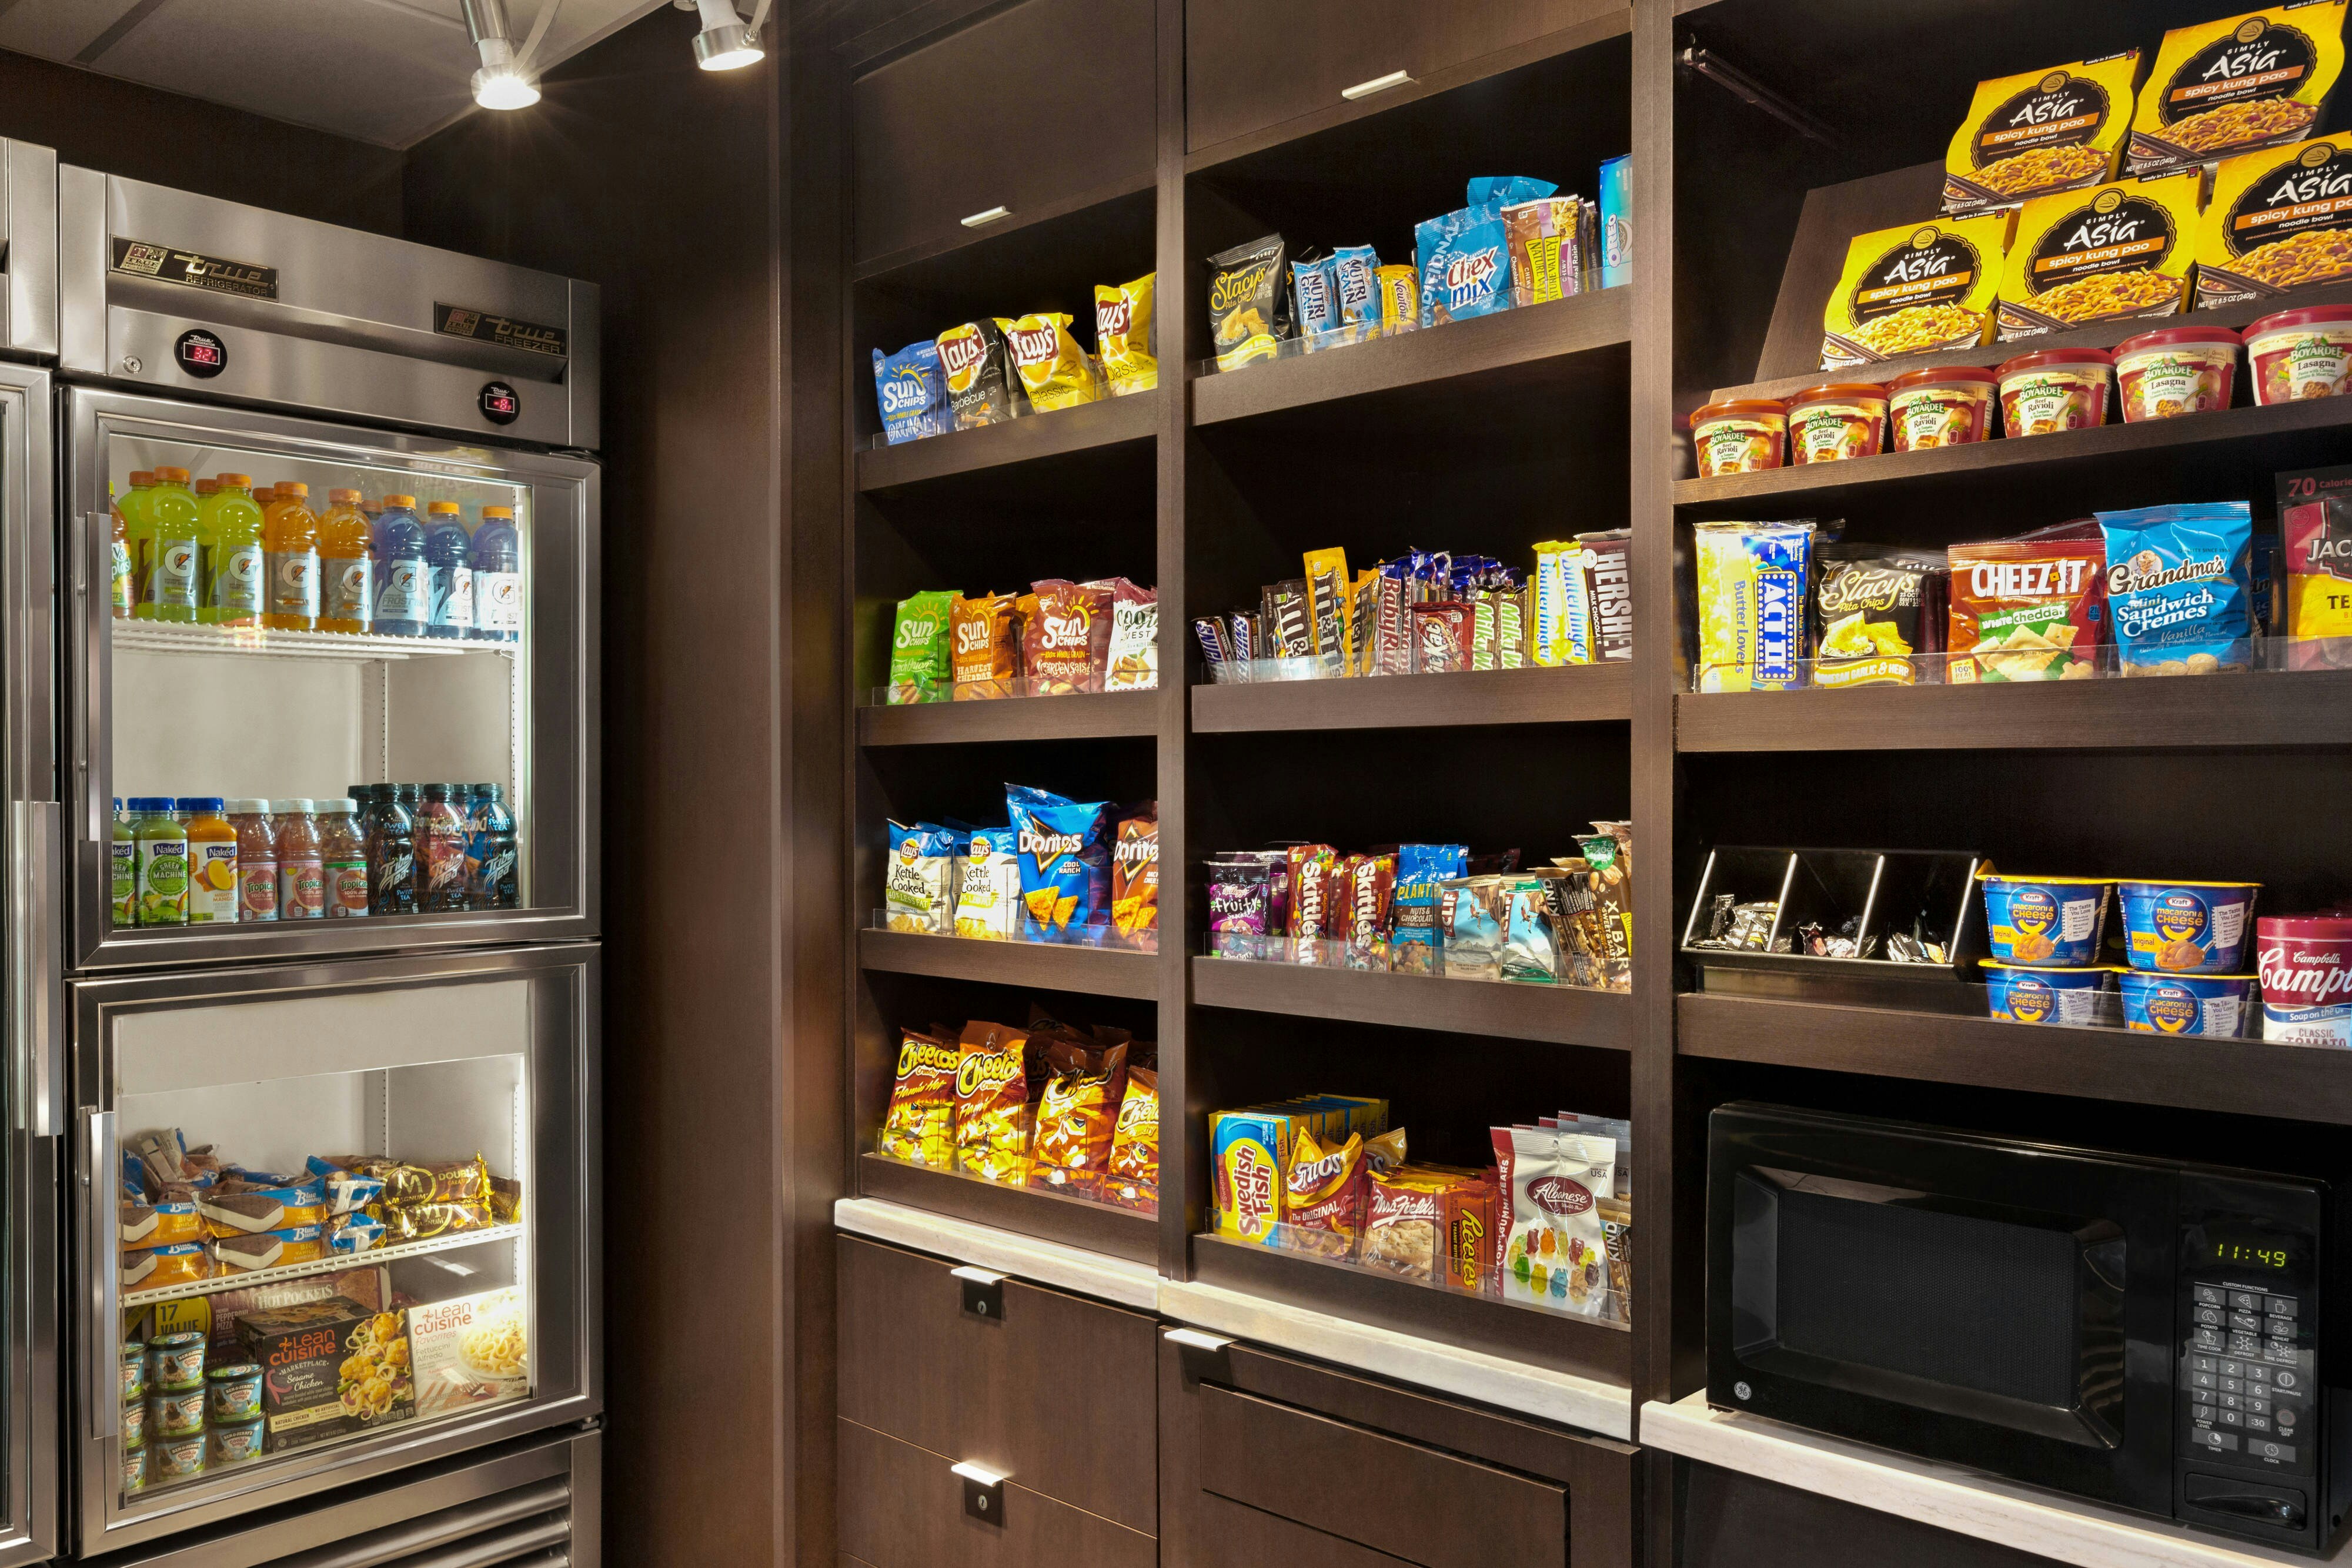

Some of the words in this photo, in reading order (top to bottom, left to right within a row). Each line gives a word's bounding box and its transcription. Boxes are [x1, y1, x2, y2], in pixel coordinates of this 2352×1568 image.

[2227, 41, 2270, 55] SIMPLY
[2203, 49, 2280, 81] Asia
[2185, 83, 2219, 98] spicy
[2223, 77, 2256, 89] kung
[2259, 71, 2288, 85] pao
[2032, 91, 2070, 103] SIMPLY
[2208, 91, 2235, 101] noodle
[2237, 87, 2257, 95] bowl
[2010, 98, 2078, 126] Asia
[1994, 129, 2024, 144] spicy
[2027, 123, 2058, 136] kung
[2059, 118, 2085, 132] pao
[2292, 165, 2339, 179] SIMPLY
[2086, 211, 2127, 225] SIMPLY
[2251, 209, 2289, 226] spicy
[2293, 201, 2330, 216] kung
[2278, 218, 2310, 229] noodle
[2311, 214, 2333, 223] bowl
[1605, 213, 1622, 268] OREO
[2063, 219, 2139, 251] Asia
[2049, 254, 2083, 268] spicy
[2086, 247, 2117, 261] kung
[2122, 242, 2149, 256] pao
[1448, 249, 1495, 287] Chex
[2073, 263, 2099, 272] noodle
[186, 275, 267, 296] REFRIGERATOR
[1211, 268, 1265, 310] Stacy's
[1452, 270, 1493, 308] mix
[1301, 276, 1316, 322] GRAIN
[1309, 274, 1326, 319] NUTRI
[1393, 278, 1408, 322] Newtons
[2237, 292, 2256, 301] (240g)
[495, 335, 560, 353] FREEZER
[1011, 326, 1054, 366] Lay's
[2290, 345, 2343, 360] BOYARDEE
[940, 335, 978, 377] Lay's
[2297, 359, 2336, 369] Lasagna
[2144, 365, 2193, 381] BOYARDEE
[2150, 378, 2186, 389] Lasagna
[898, 396, 926, 408] CHIPS
[951, 389, 985, 412] Barbecue
[1030, 385, 1070, 404] Classic
[2019, 386, 2063, 402] BOYARDEE
[1906, 402, 1945, 416] BOYARDEE
[2028, 401, 2054, 412] Ravioli
[1805, 417, 1843, 430] BOYARDEE
[1914, 417, 1936, 427] Ravioli
[1710, 432, 1746, 444] BOYARDEE
[1812, 432, 1835, 440] Ravioli
[1717, 446, 1738, 454] Ravioli
[2288, 477, 2316, 497] 70
[2107, 556, 2225, 596] Grandma's
[1820, 570, 1920, 611] Stacy's
[1536, 562, 1551, 660] Butterfinger
[1561, 558, 1588, 660] Butterfinger
[1733, 580, 1746, 627] Butter
[1763, 582, 1787, 636] ACT
[1839, 601, 1859, 613] Pita
[1860, 597, 1885, 610] Chips
[2117, 588, 2214, 622] Sandwich
[2014, 606, 2064, 623] cheddar
[2122, 603, 2207, 638] Cremes
[1592, 605, 1602, 645] CHOCOLATE
[2161, 624, 2205, 643] Vanilla
[909, 637, 930, 646] CHIPS
[970, 638, 989, 651] CHIPS
[1057, 636, 1087, 646] CHIPS
[1735, 628, 1750, 674] Lovers
[957, 663, 993, 674] HARVEST
[957, 672, 993, 681] CHEDDAR
[1850, 664, 1876, 680] GARLIC
[1877, 661, 1887, 676] &
[1888, 664, 1909, 677] HERB
[156, 845, 182, 854] Naked
[1018, 829, 1083, 854] Doritos
[209, 848, 234, 857] Naked
[896, 864, 920, 880] Kettle
[892, 878, 925, 895] Cooked
[1355, 862, 1377, 948] Skittles
[1544, 879, 1558, 917] KIND
[1442, 894, 1456, 925] CLIF
[2013, 903, 2048, 911] macaroni
[1994, 930, 2011, 938] original
[2133, 937, 2154, 946] original
[2294, 951, 2341, 965] Campbell's
[2290, 1013, 2308, 1021] Soup
[2299, 1028, 2334, 1038] CLASSIC
[1501, 1159, 1509, 1195] BEARS
[1591, 1171, 1608, 1179] USA
[1234, 1145, 1262, 1235] Swedish
[1252, 1165, 1272, 1215] Fish
[1533, 1182, 1589, 1205] Albanese
[1292, 1213, 1301, 1221] The
[1302, 1203, 1339, 1221] ORIGINAL
[1500, 1198, 1509, 1233] GUMMI
[1461, 1208, 1484, 1290] Reese's
[2218, 1244, 2286, 1266] 11:49
[2242, 1284, 2268, 1292] FUNCTIONS
[161, 1304, 179, 1322] 17
[435, 1303, 470, 1319] Lean
[293, 1329, 335, 1349] Lean
[280, 1360, 327, 1375] MARKETPLACE
[2201, 1359, 2207, 1369] 1
[2228, 1364, 2234, 1373] 2
[287, 1372, 314, 1383] Sesame
[2256, 1369, 2261, 1378] 3
[294, 1380, 323, 1392] Chicken
[2272, 1388, 2301, 1397] START/PAUSE
